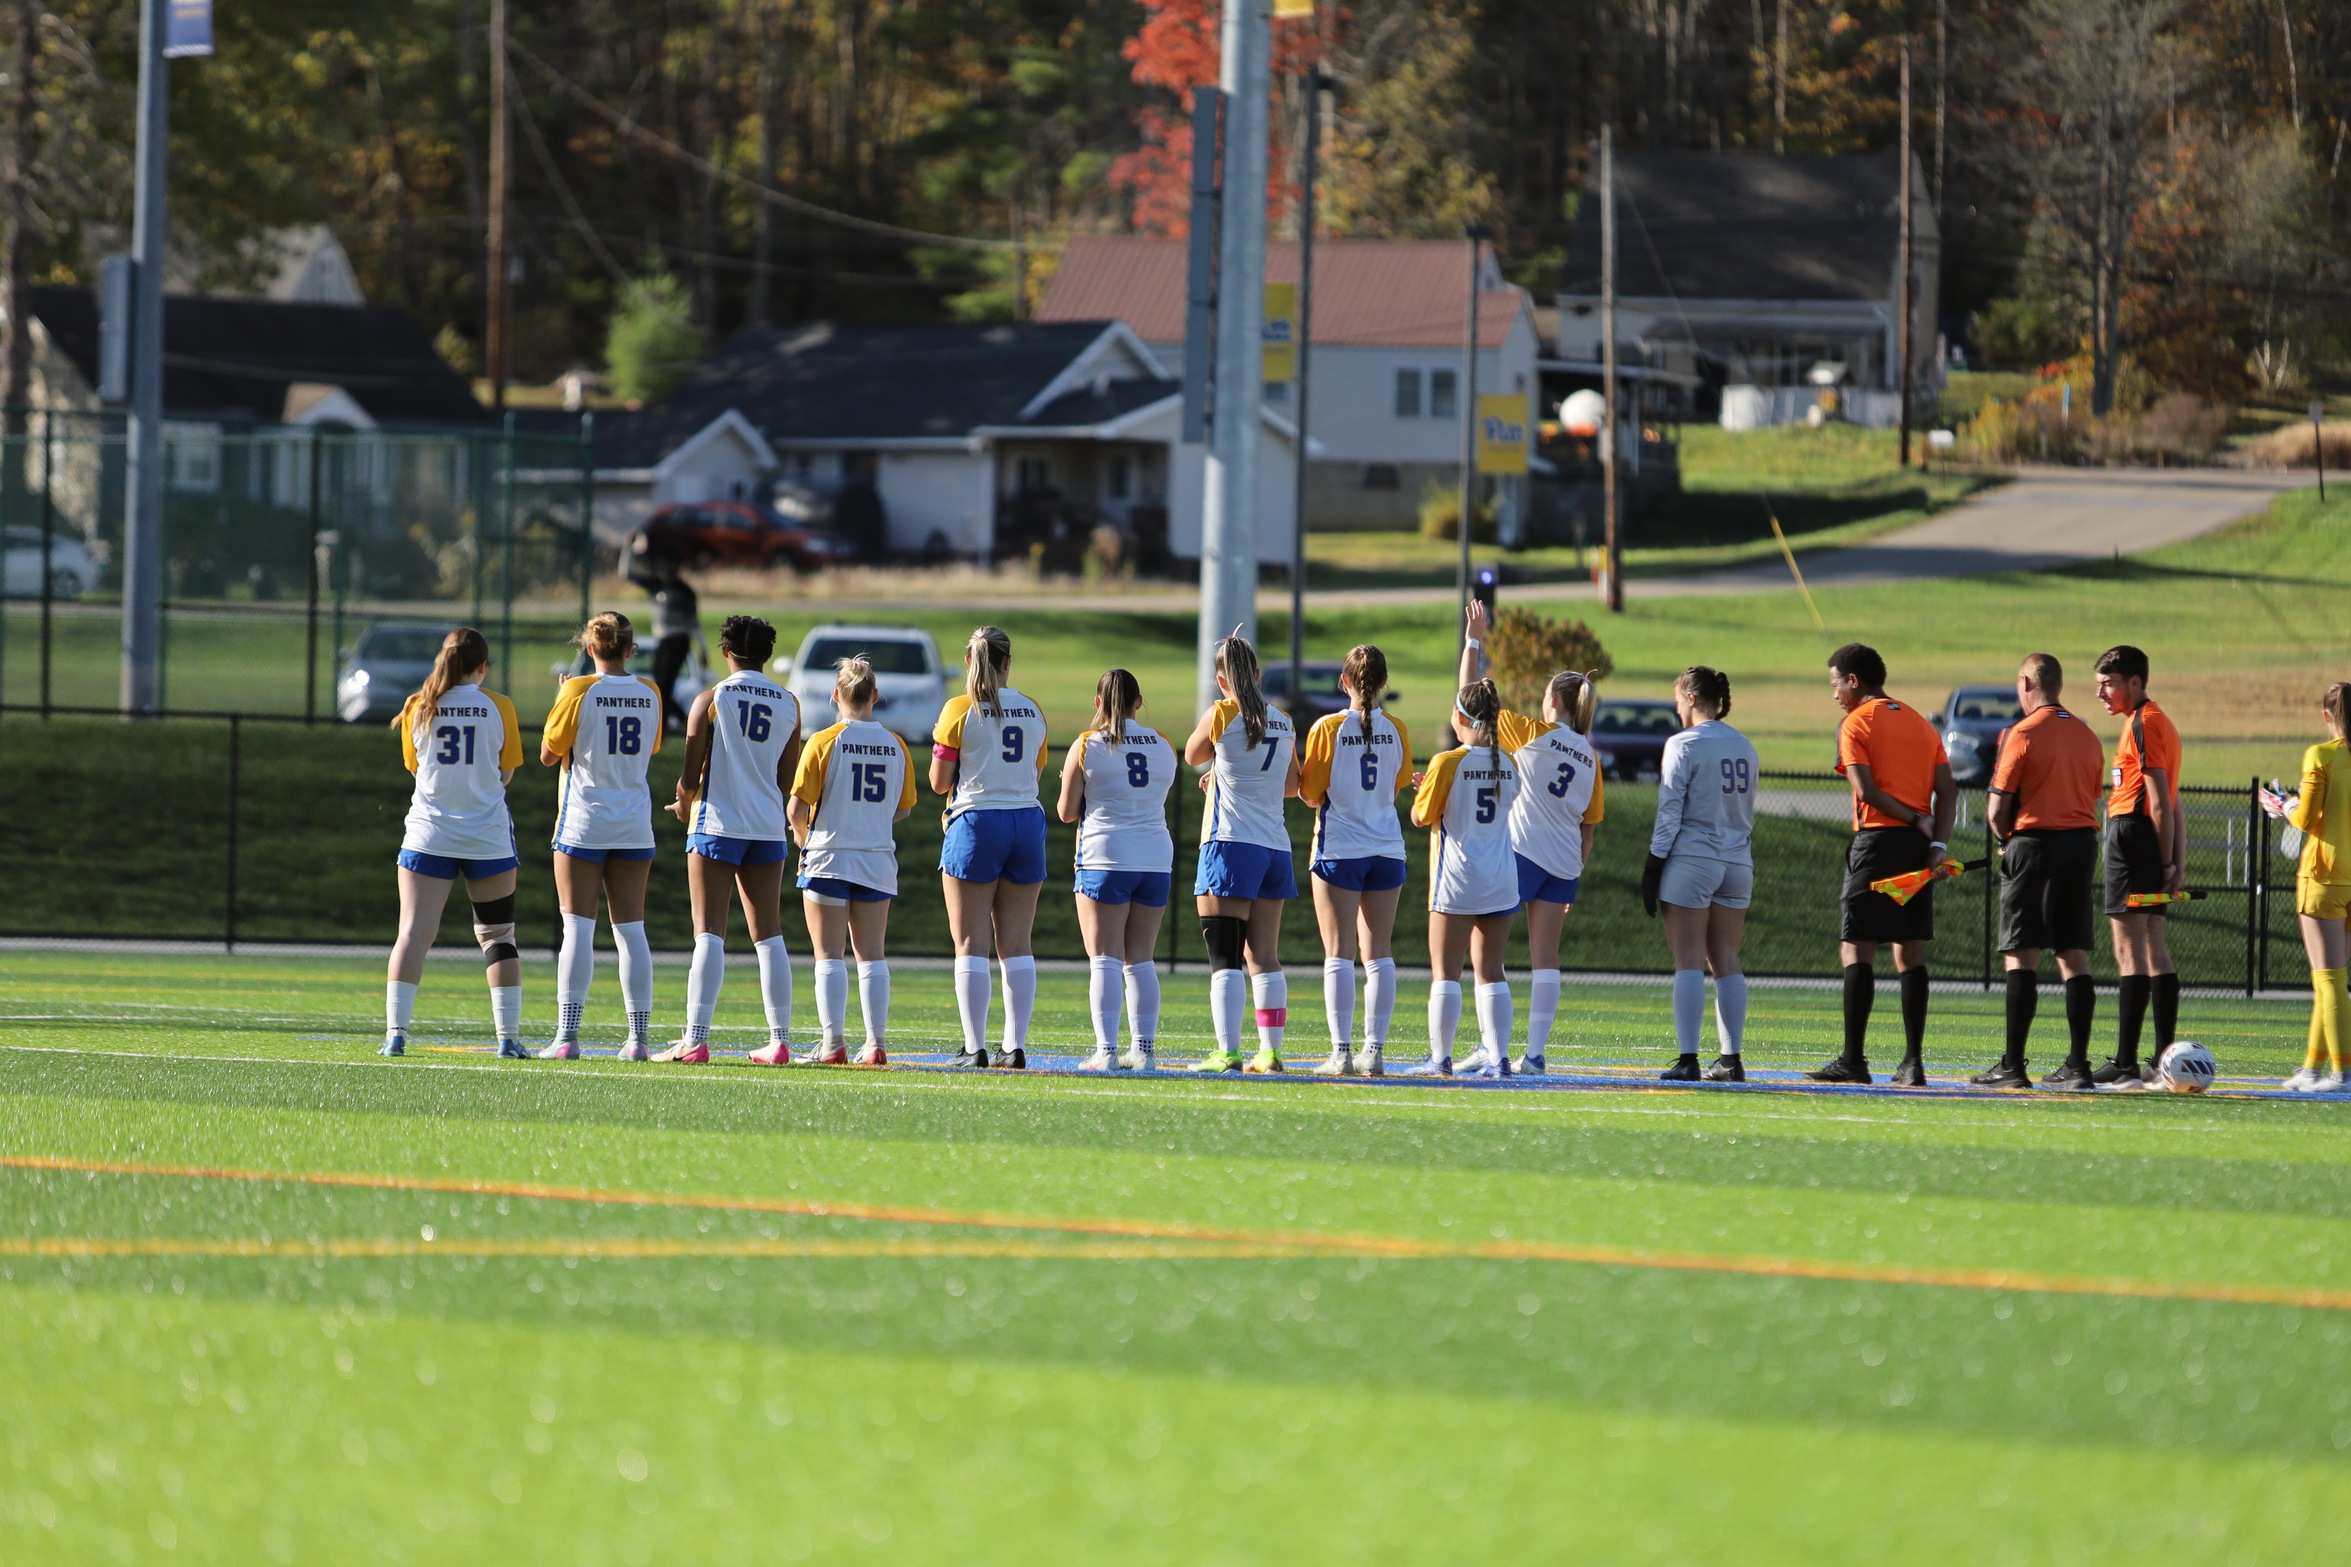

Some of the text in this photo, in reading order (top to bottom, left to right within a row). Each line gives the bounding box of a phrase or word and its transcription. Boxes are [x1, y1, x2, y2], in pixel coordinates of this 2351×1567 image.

[435, 706, 488, 718] ANTHERS
[595, 696, 651, 708] PANTHERS
[983, 708, 1036, 718] PATHERS
[606, 716, 641, 755] 18
[738, 700, 772, 743] 16
[436, 725, 476, 765] 31
[842, 743, 896, 757] PANTHERS
[1002, 725, 1024, 763] 9
[1102, 735, 1158, 745] PTHERS
[1260, 736, 1279, 771] 7
[1550, 738, 1594, 768] PANTHERS
[851, 762, 886, 803] 15
[1125, 752, 1150, 788] 8
[1359, 753, 1379, 792] 6
[1547, 762, 1576, 799] 3
[1720, 758, 1750, 794] 99
[1475, 787, 1496, 824] 5
